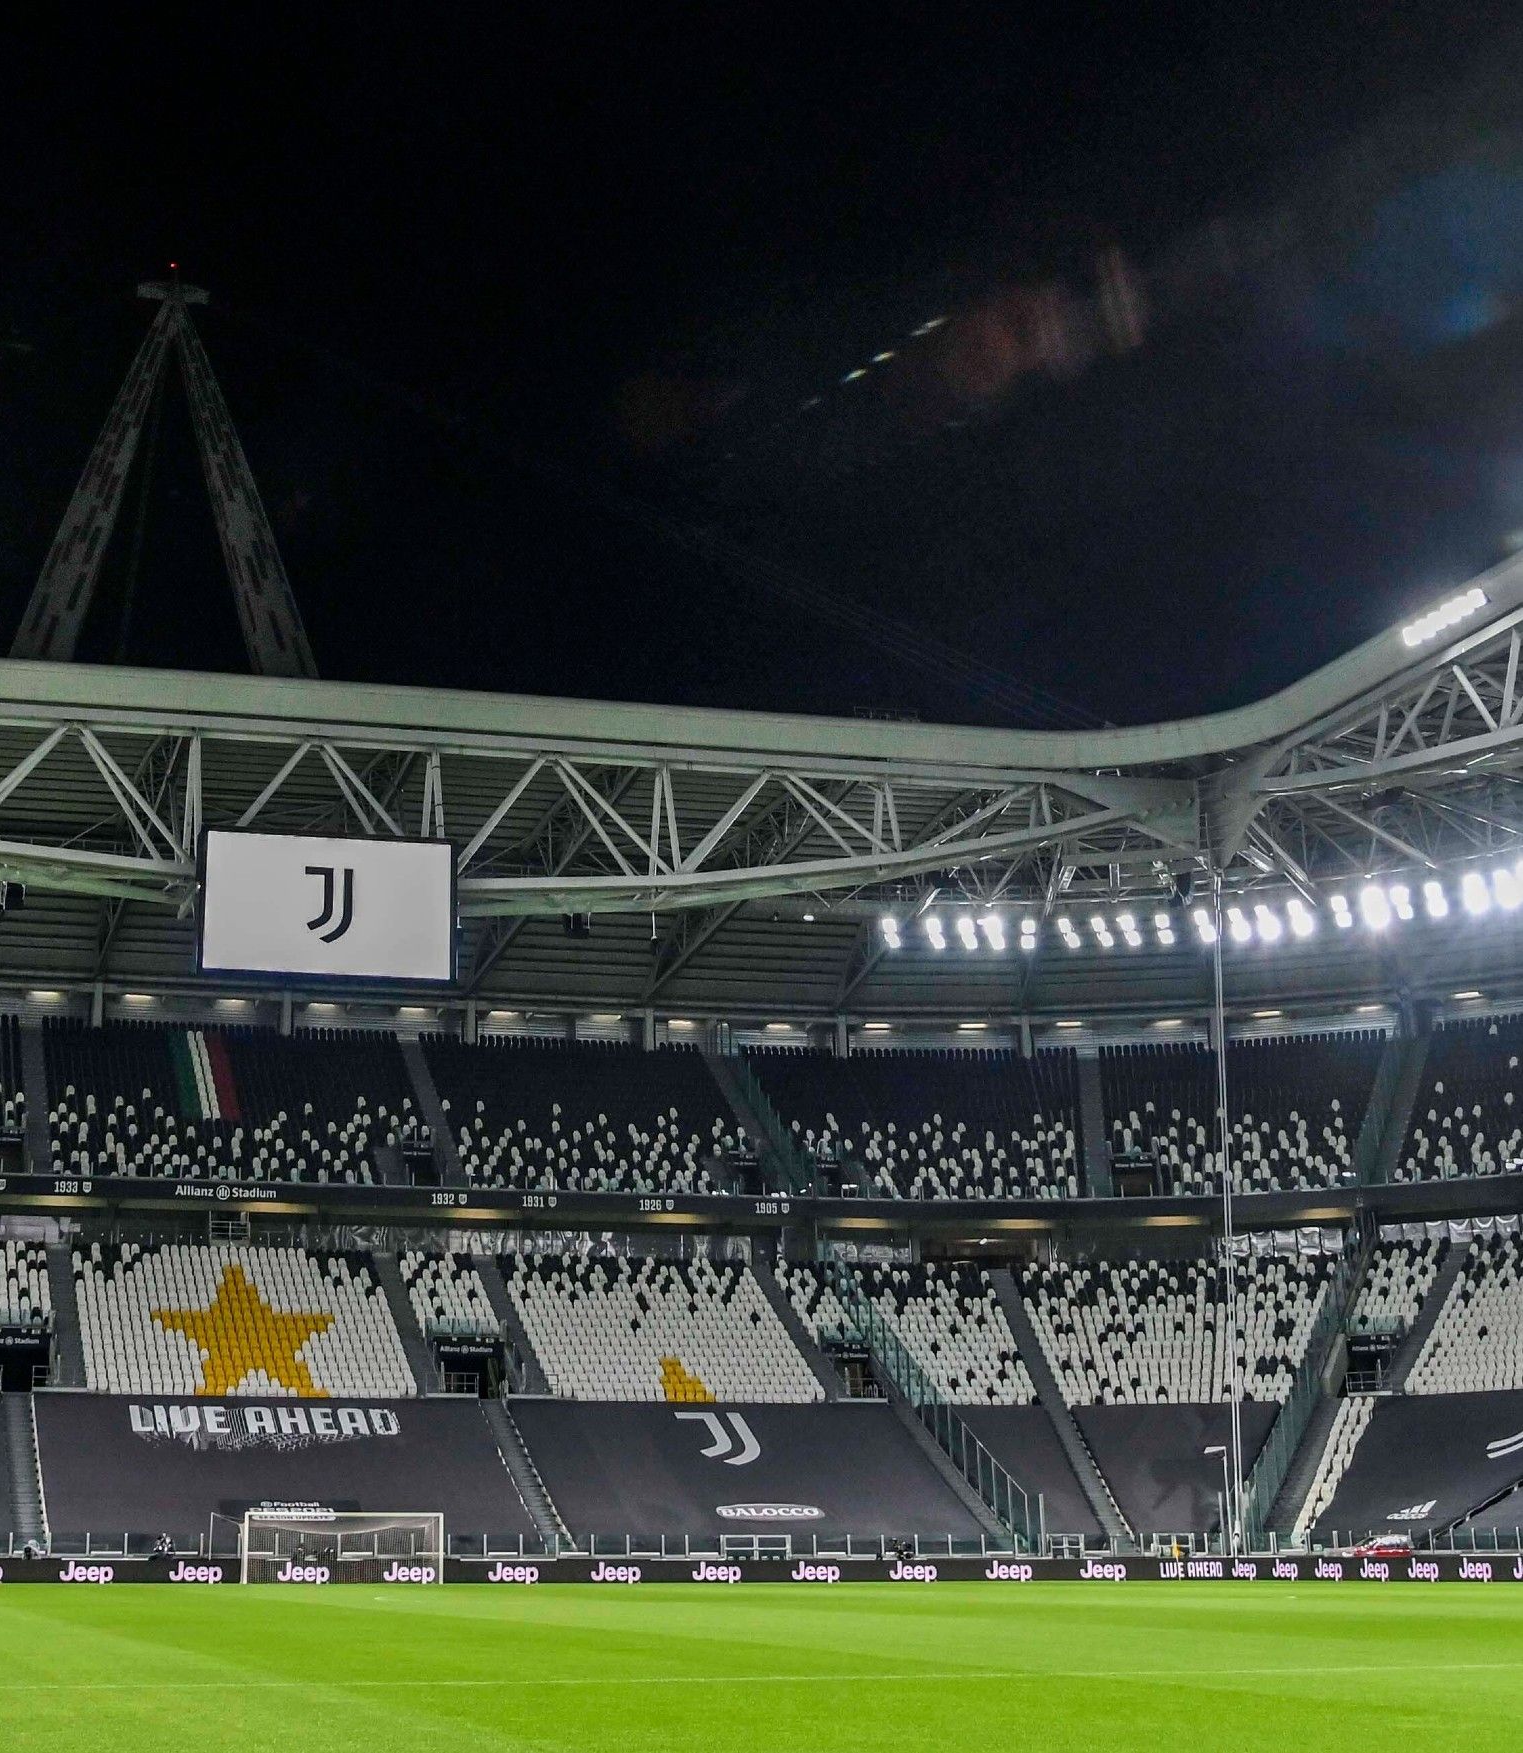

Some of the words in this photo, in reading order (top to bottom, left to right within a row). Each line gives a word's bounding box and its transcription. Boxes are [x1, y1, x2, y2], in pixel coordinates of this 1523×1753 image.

[54, 1181, 78, 1193] 1933
[175, 1185, 213, 1196] Allianz
[232, 1187, 276, 1198] Stadium
[431, 1193, 454, 1205] 1932
[522, 1196, 544, 1207] 1931
[639, 1199, 661, 1211] 1926
[755, 1202, 778, 1214] 1905
[128, 1405, 231, 1433] LIVE
[244, 1407, 400, 1436] AHEAD
[721, 1507, 819, 1517] BALOCCO
[60, 1561, 113, 1584] Jeep
[169, 1561, 222, 1584] Jeep
[277, 1561, 330, 1584] Jeep
[383, 1562, 435, 1584] Jeep
[488, 1562, 539, 1584] Jeep
[591, 1562, 641, 1584] Jeep
[692, 1562, 741, 1583] Jeep
[792, 1561, 841, 1583] Jeep
[889, 1561, 938, 1582] Jeep
[985, 1560, 1033, 1582] Jeep
[1080, 1560, 1127, 1581] Jeep
[1159, 1562, 1185, 1578] LIVE
[1187, 1562, 1223, 1577] AHEAD
[1232, 1559, 1257, 1581] Jeep
[1273, 1559, 1299, 1581] Jeep
[1314, 1558, 1343, 1581] Jeep
[1360, 1558, 1389, 1582] Jeep
[1408, 1558, 1439, 1581] Jeep
[1459, 1558, 1492, 1581] Jeep
